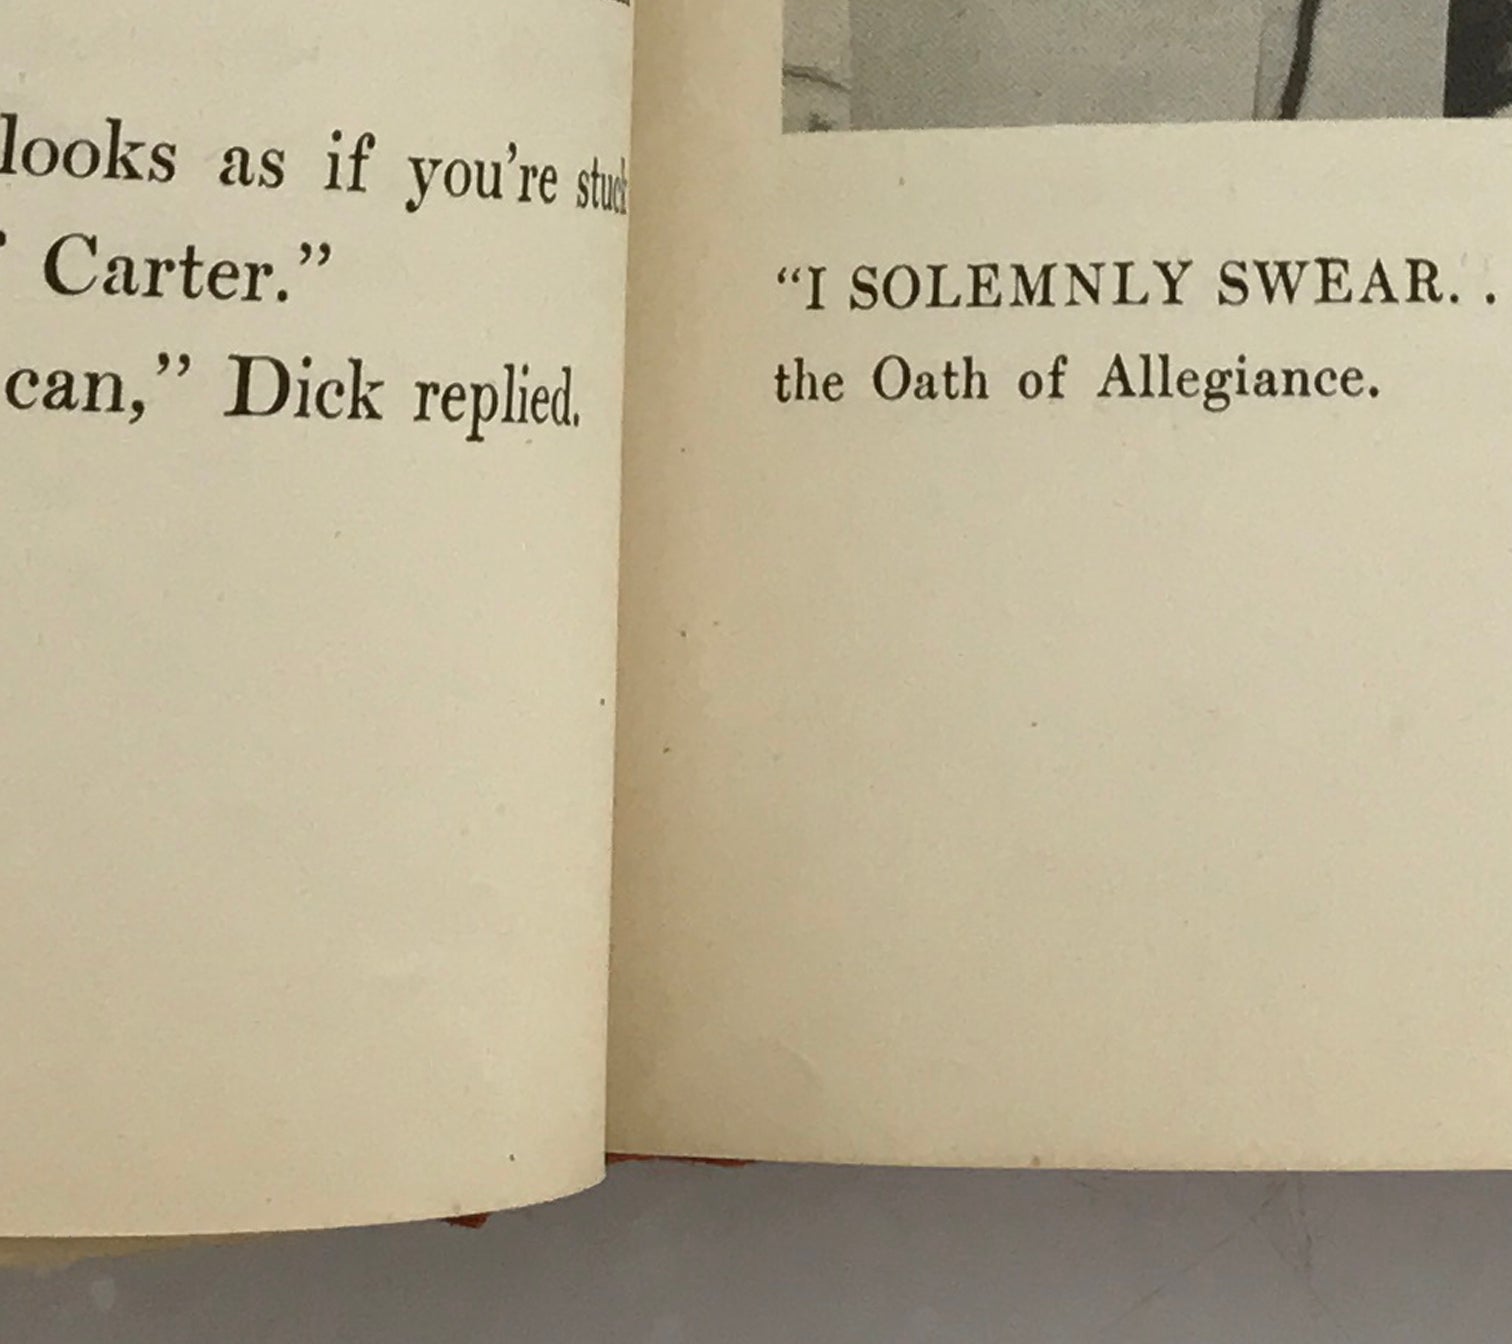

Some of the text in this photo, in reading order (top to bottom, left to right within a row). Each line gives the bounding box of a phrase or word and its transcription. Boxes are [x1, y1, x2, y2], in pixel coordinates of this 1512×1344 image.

[0, 110, 178, 185] looks
[217, 144, 286, 190] as
[322, 127, 378, 195] if
[403, 140, 559, 215] you’re
[42, 231, 333, 304] Carter.”
[848, 257, 1195, 312] SOLEMNLY
[3, 350, 581, 445] can,” Dick replied.
[772, 351, 1381, 415] the Oath of Allegiance.
